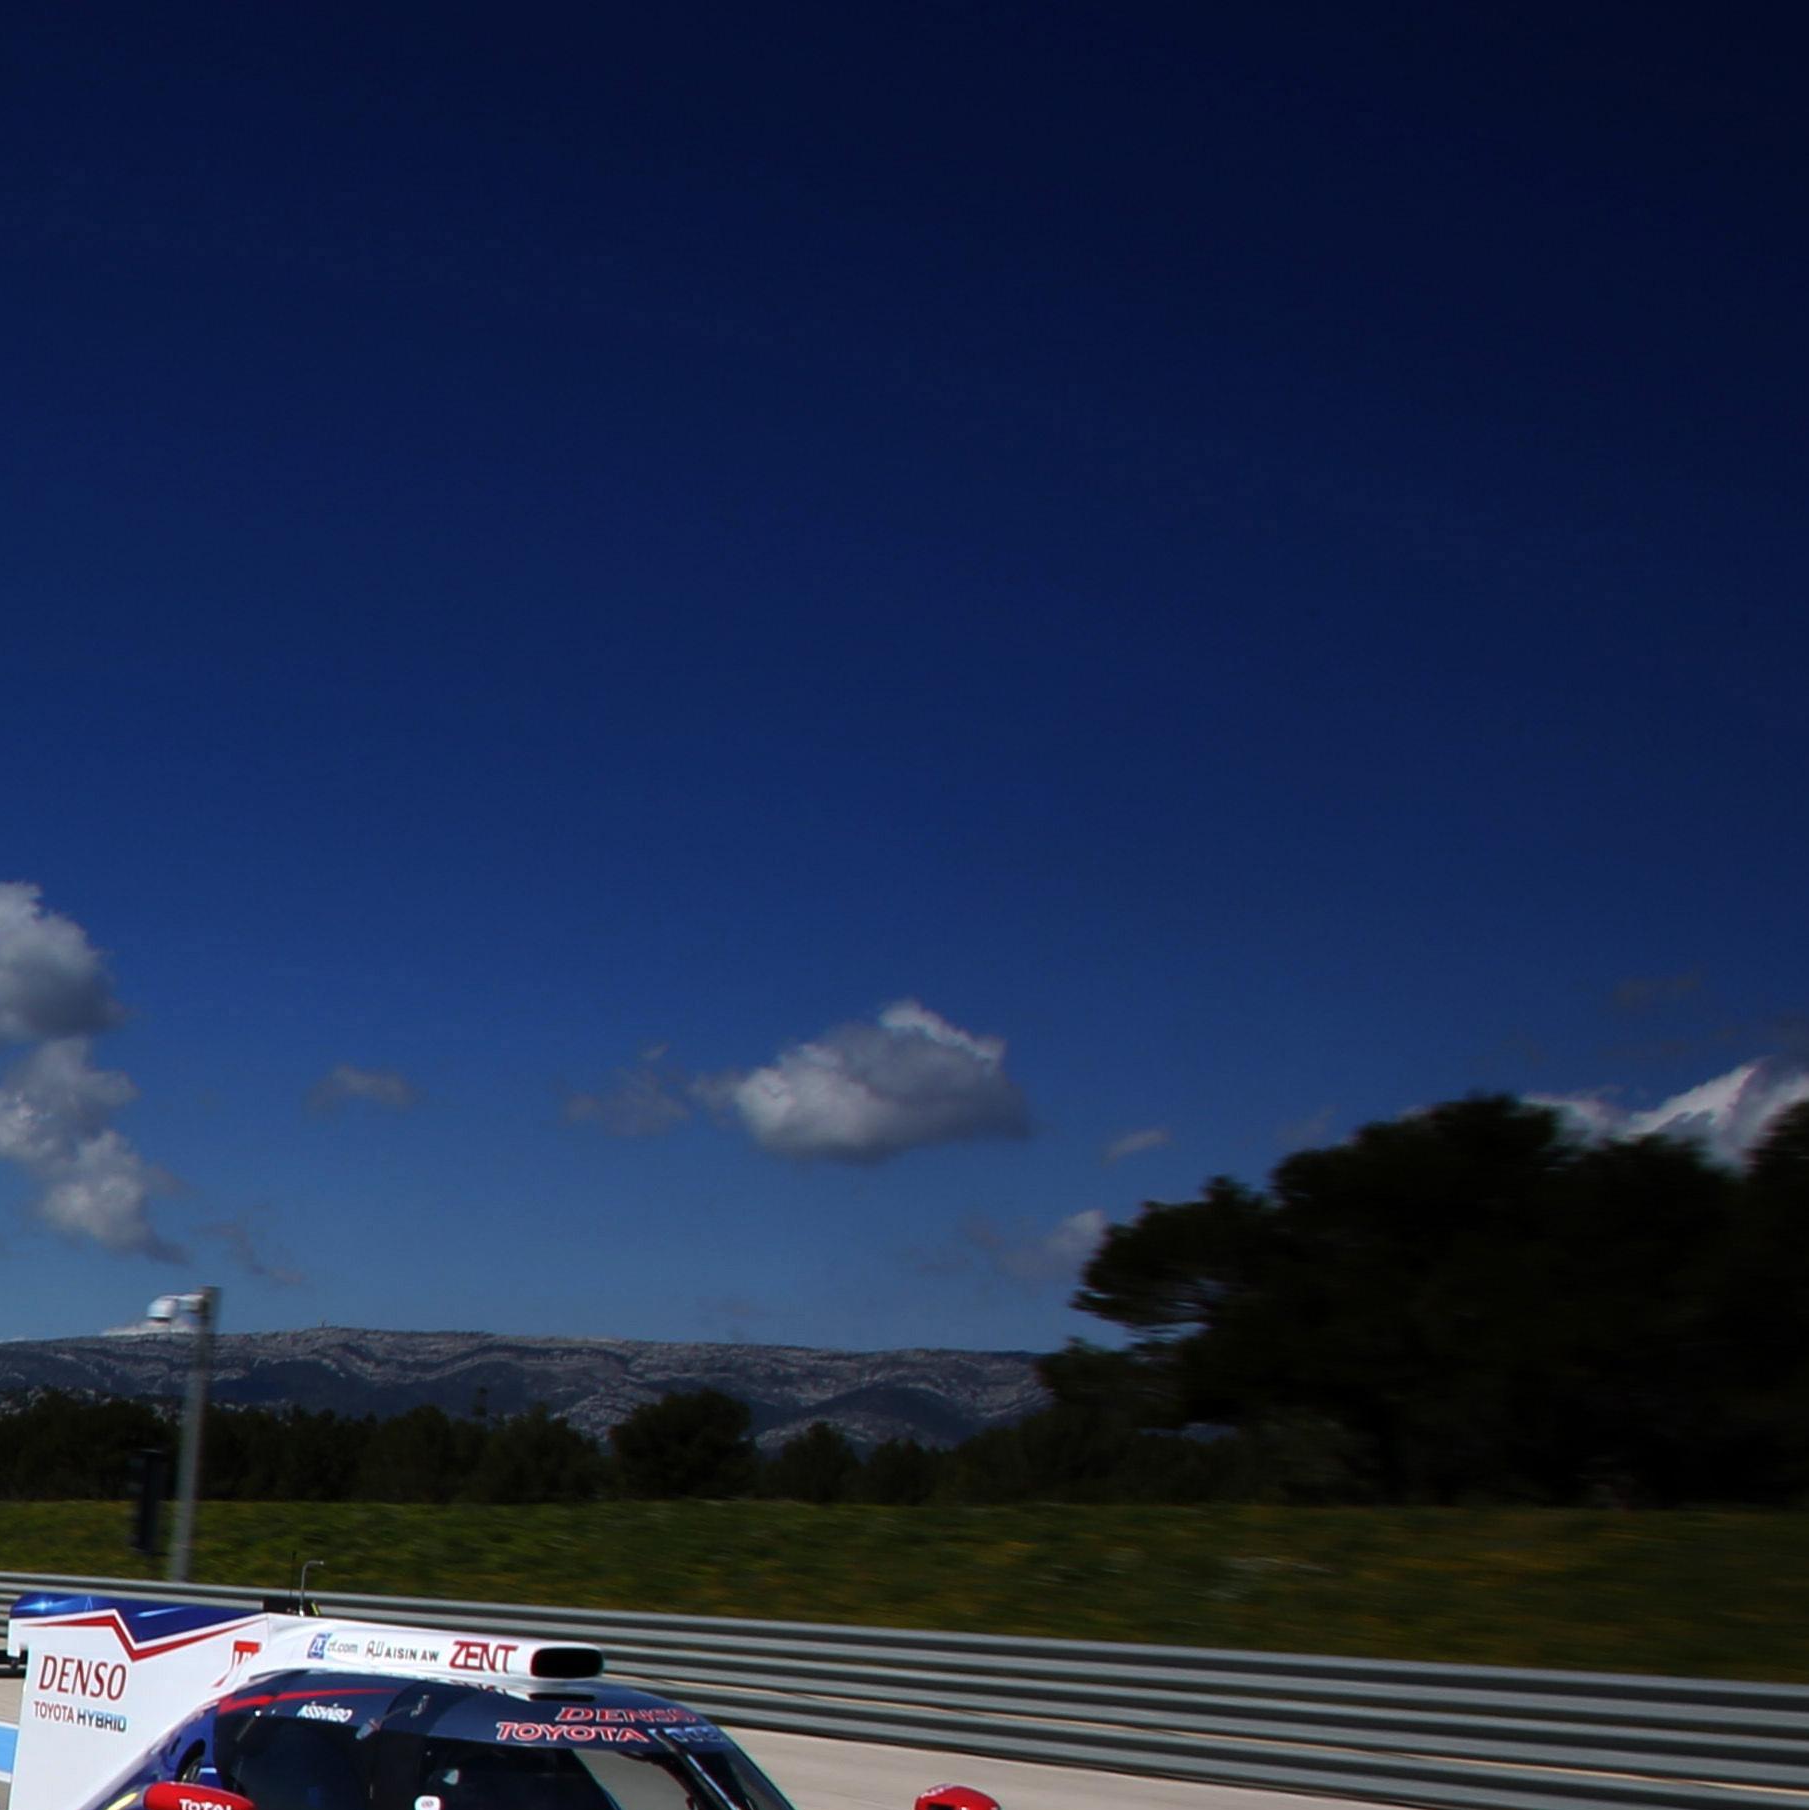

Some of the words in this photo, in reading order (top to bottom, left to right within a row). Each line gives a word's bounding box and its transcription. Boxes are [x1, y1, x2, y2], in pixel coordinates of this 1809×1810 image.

[384, 1647, 418, 1660] AISIN
[420, 1650, 439, 1662] AW
[449, 1640, 519, 1674] ZENT
[39, 1655, 127, 1701] DENSO
[34, 1701, 74, 1724] TOYOTA
[76, 1708, 127, 1732] HYBRID
[496, 1722, 650, 1743] TOYOTA
